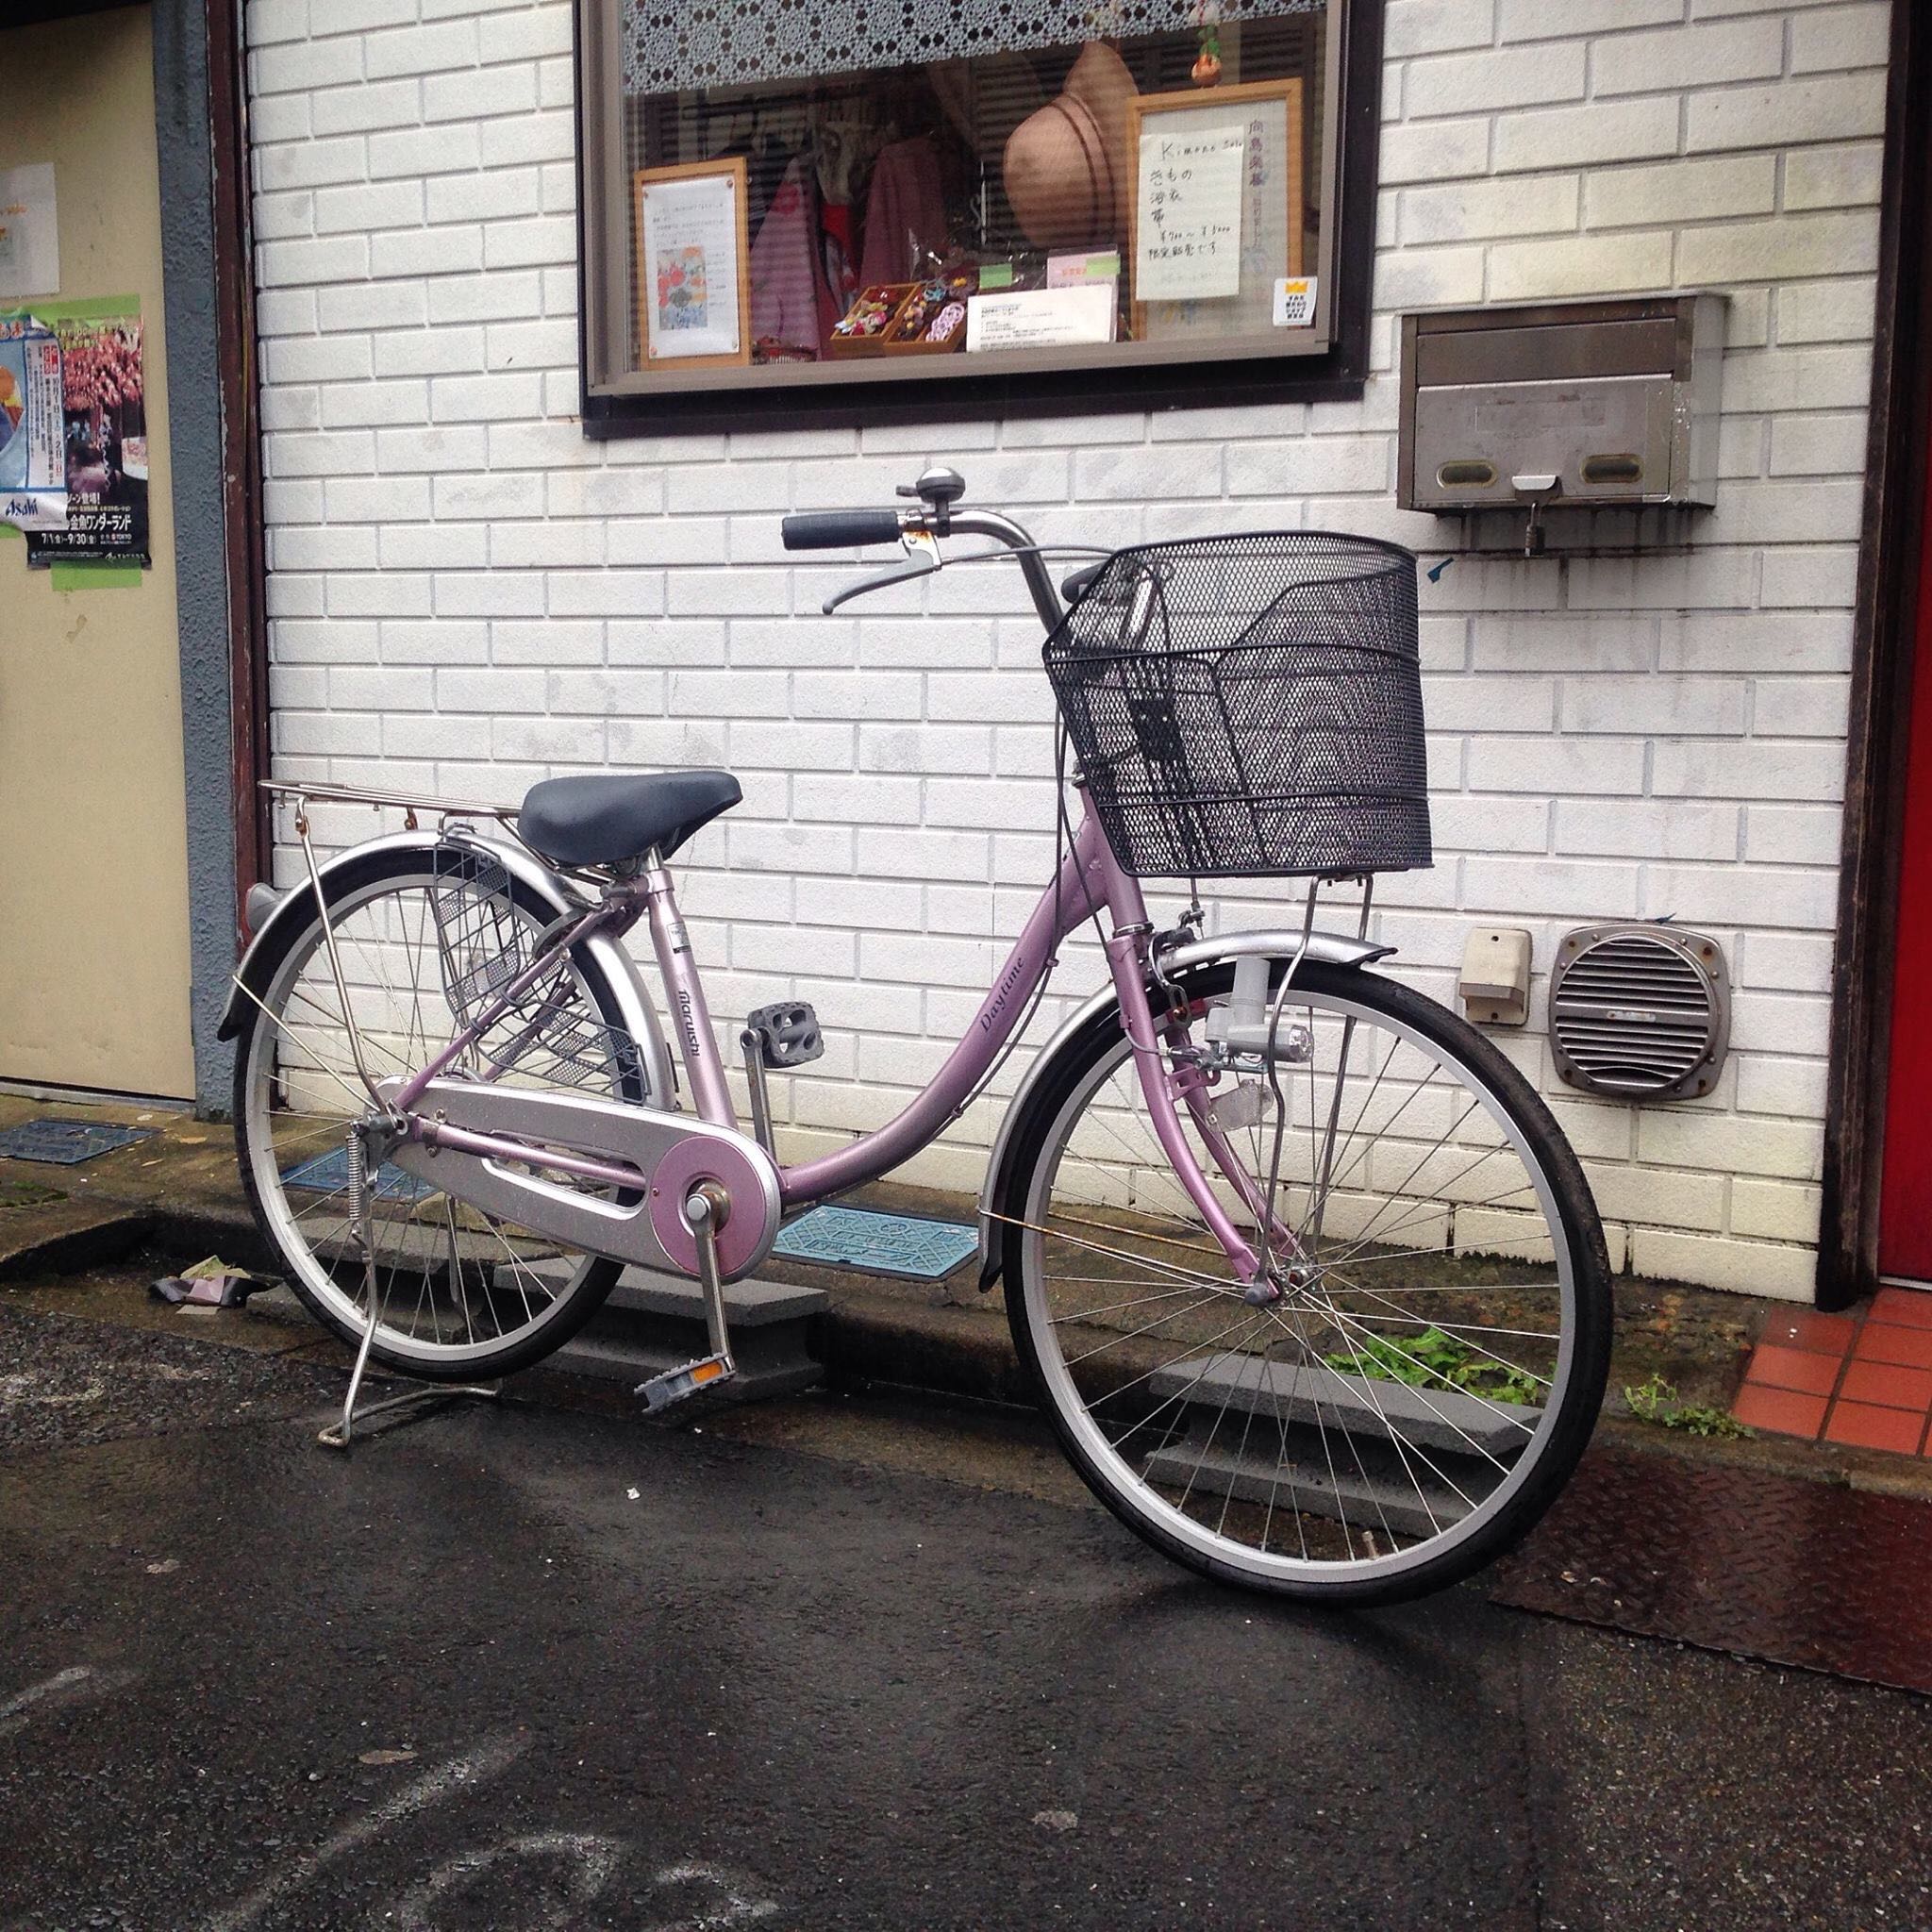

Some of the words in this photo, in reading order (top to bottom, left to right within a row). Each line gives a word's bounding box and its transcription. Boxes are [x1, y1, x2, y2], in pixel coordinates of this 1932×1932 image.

[1161, 141, 1216, 160] Kimono
[1150, 167, 1192, 186] きもの
[6, 498, 39, 516] Asahi
[67, 512, 132, 530] 金魚ワンダーランド
[980, 958, 1025, 1032] Daytime
